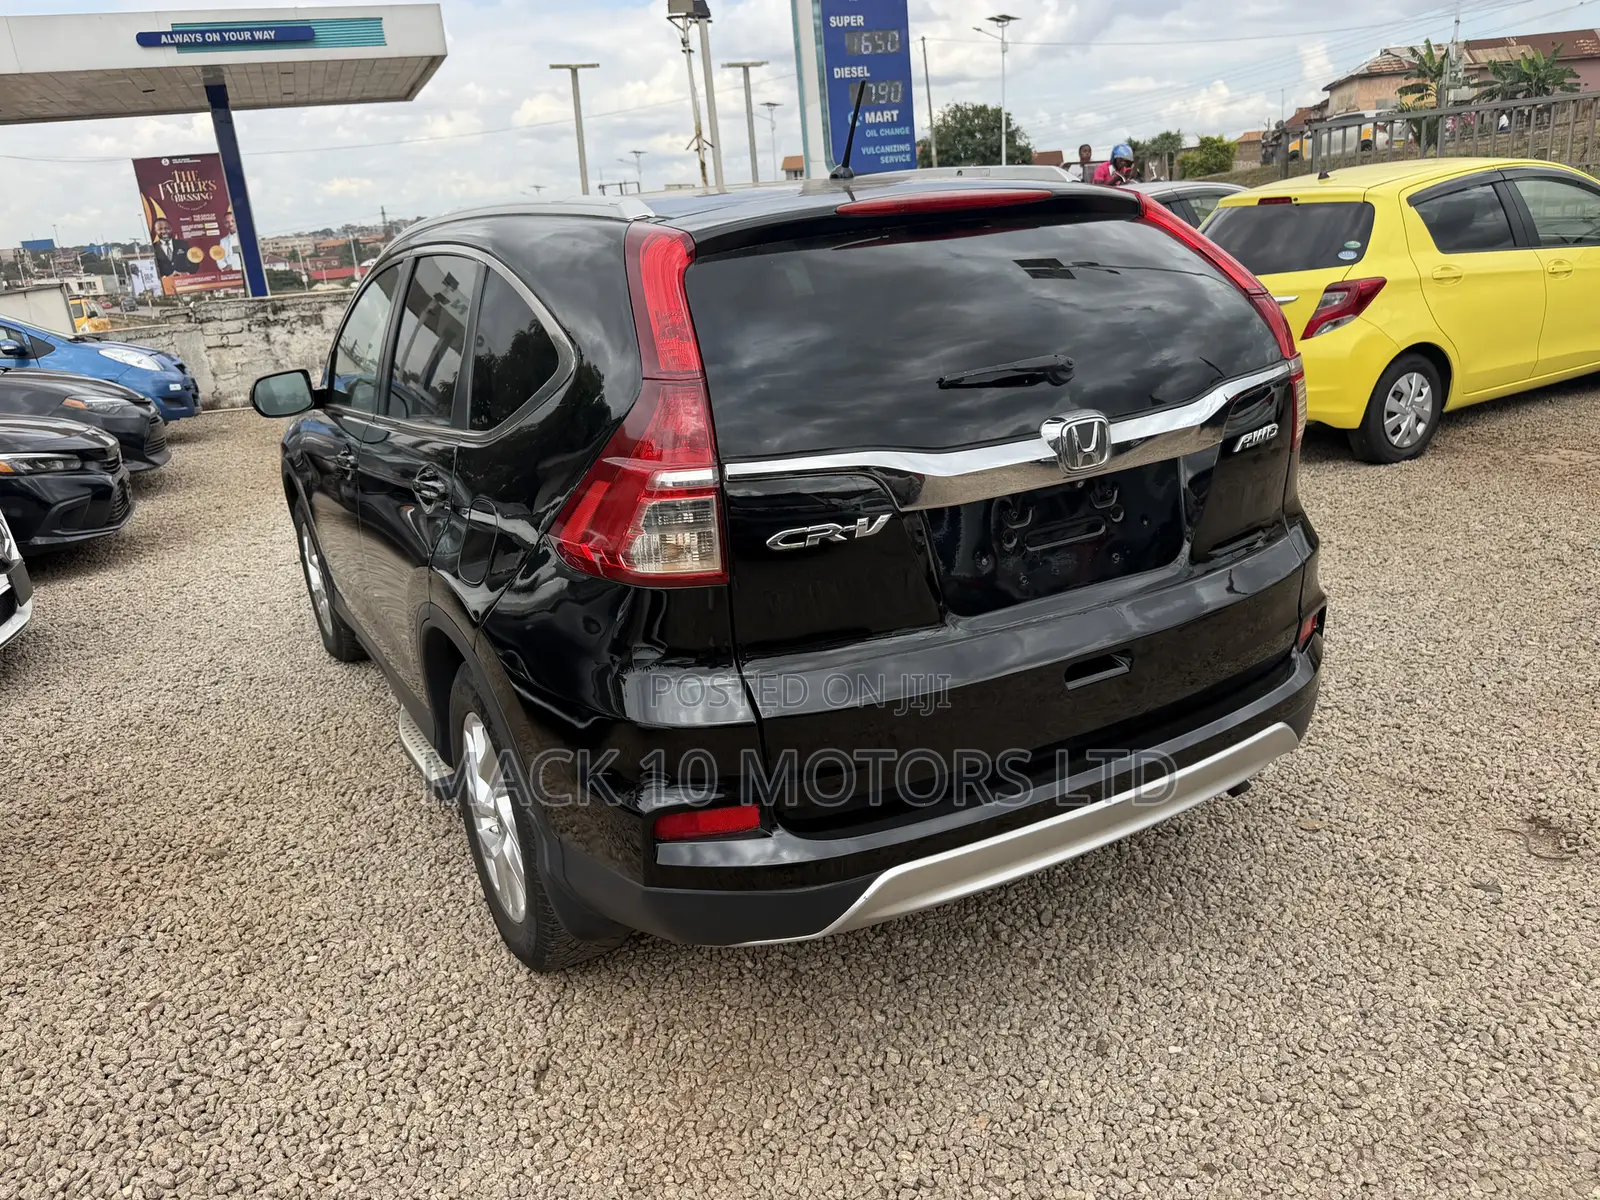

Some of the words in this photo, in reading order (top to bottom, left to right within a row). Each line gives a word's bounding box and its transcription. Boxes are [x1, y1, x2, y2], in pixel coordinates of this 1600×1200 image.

[829, 15, 865, 28] SUPER
[160, 32, 203, 44] ALWAYS
[205, 31, 221, 42] ON
[221, 30, 252, 42] YOUR
[252, 29, 276, 41] WAY
[833, 66, 871, 79] DIESEL
[864, 109, 900, 124] MART
[865, 128, 878, 138] OIL
[879, 126, 911, 137] CHANGE
[861, 144, 911, 155] VULCANIZING
[880, 152, 912, 164] SERVICE
[172, 170, 200, 184] THE
[1232, 422, 1279, 454] AWD
[766, 513, 893, 552] CR-V
